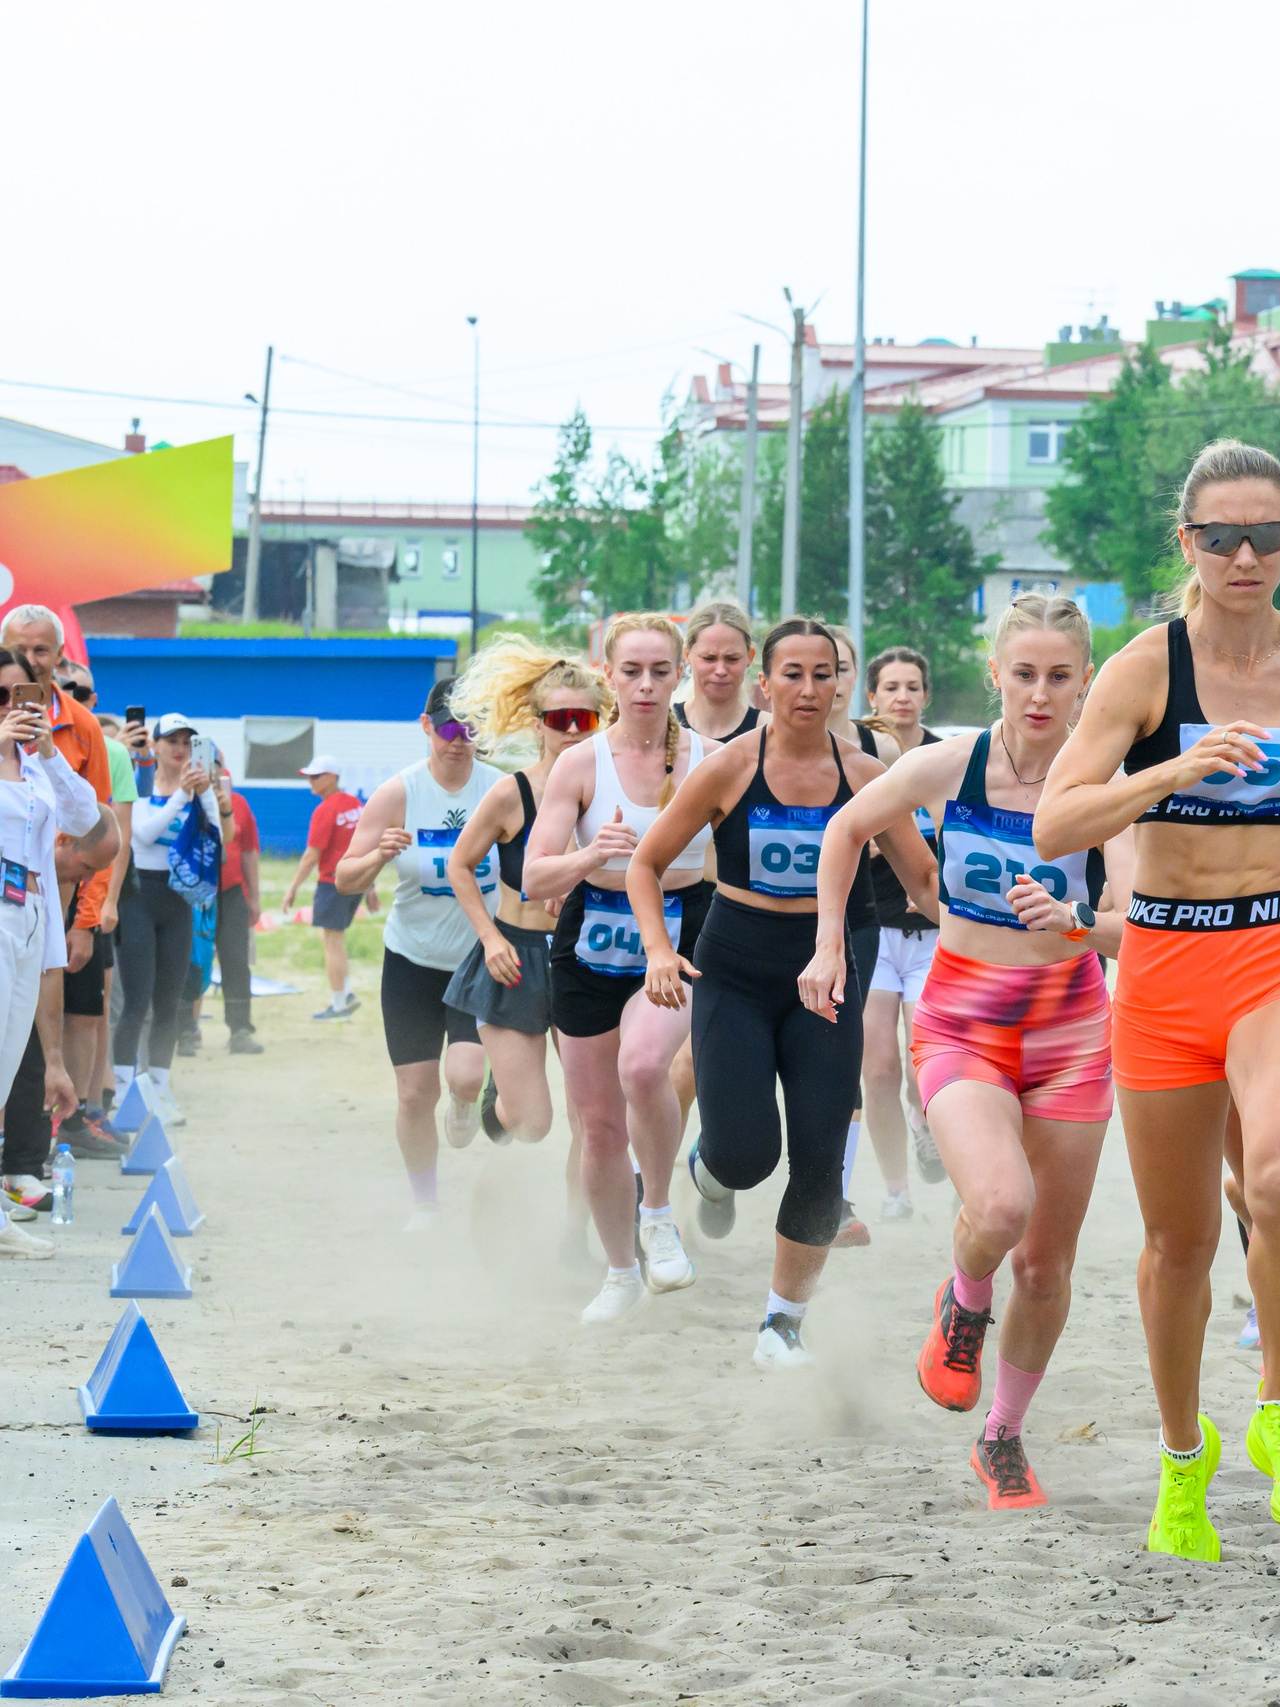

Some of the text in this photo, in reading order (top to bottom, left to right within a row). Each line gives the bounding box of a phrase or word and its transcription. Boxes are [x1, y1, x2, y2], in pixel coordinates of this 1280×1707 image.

[964, 851, 1068, 902] 210
[1127, 896, 1171, 925] NIKE
[1172, 904, 1235, 927] PRO
[587, 923, 646, 956] 04
